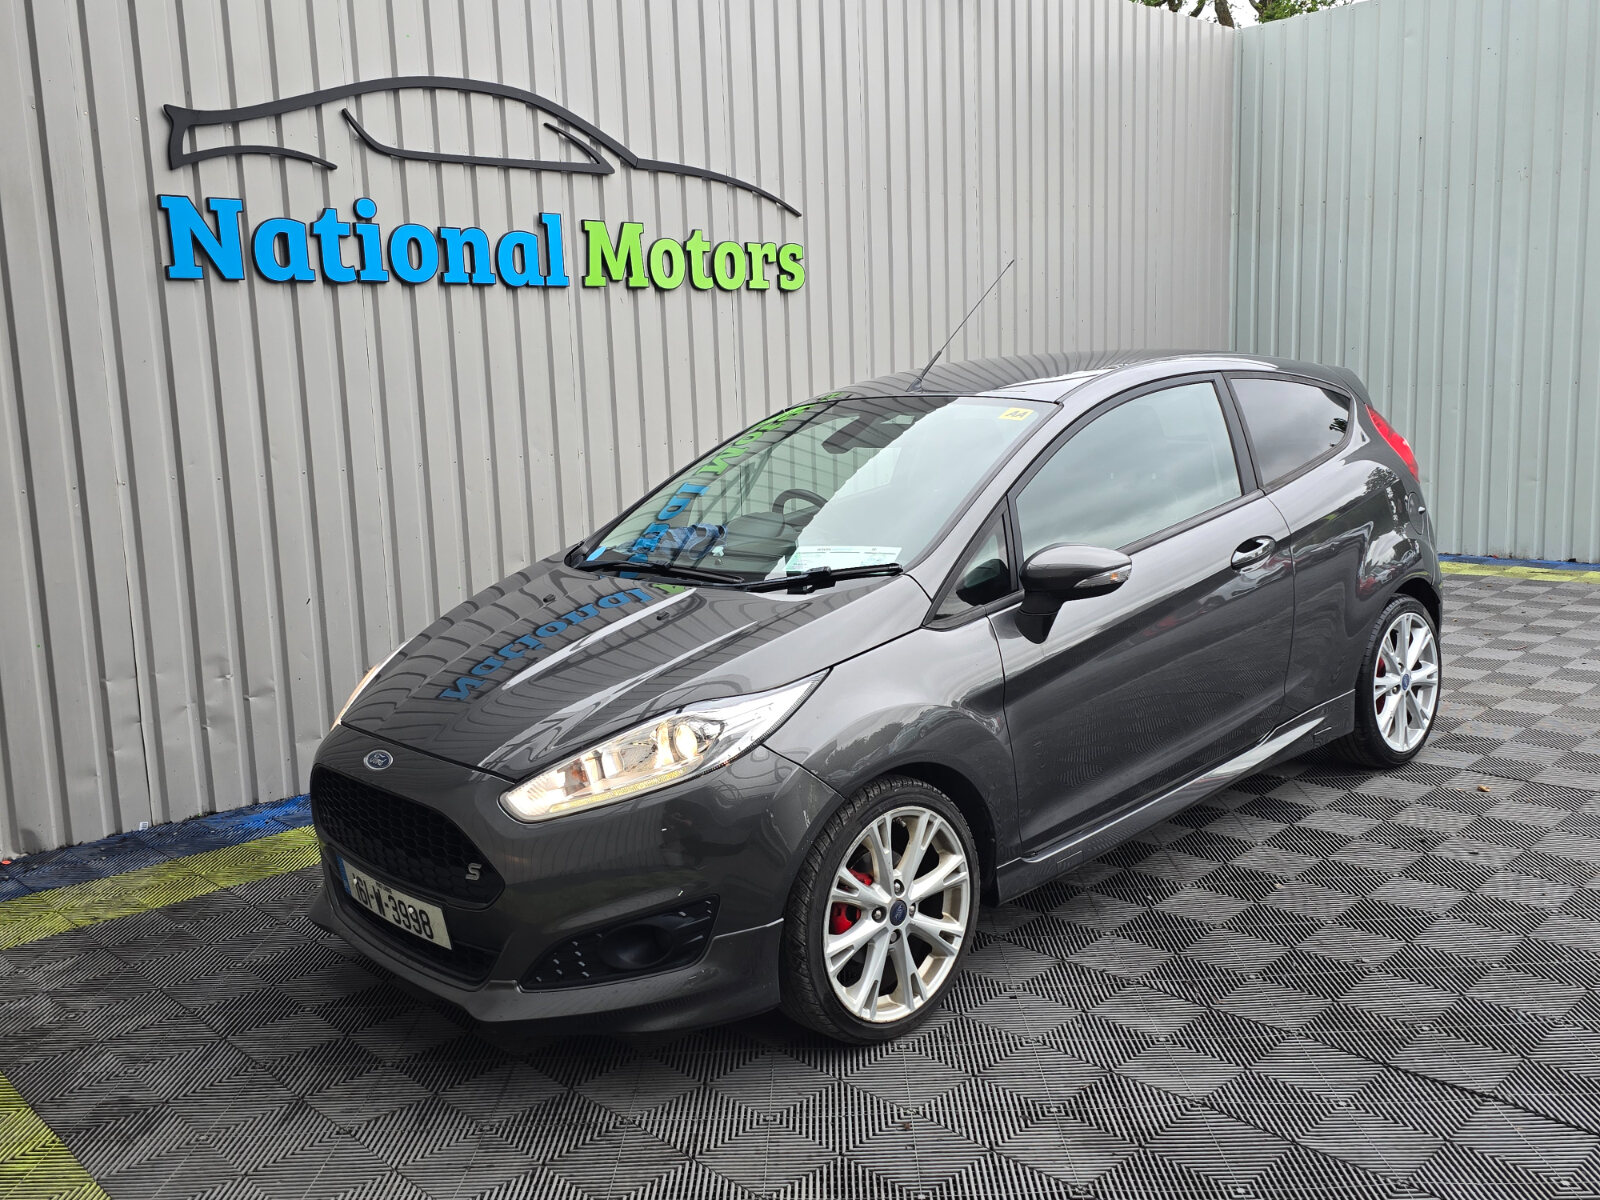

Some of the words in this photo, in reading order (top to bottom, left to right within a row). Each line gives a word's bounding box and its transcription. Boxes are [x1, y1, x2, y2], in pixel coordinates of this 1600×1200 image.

[157, 194, 570, 287] National
[581, 219, 806, 291] Motors
[465, 862, 482, 881] S
